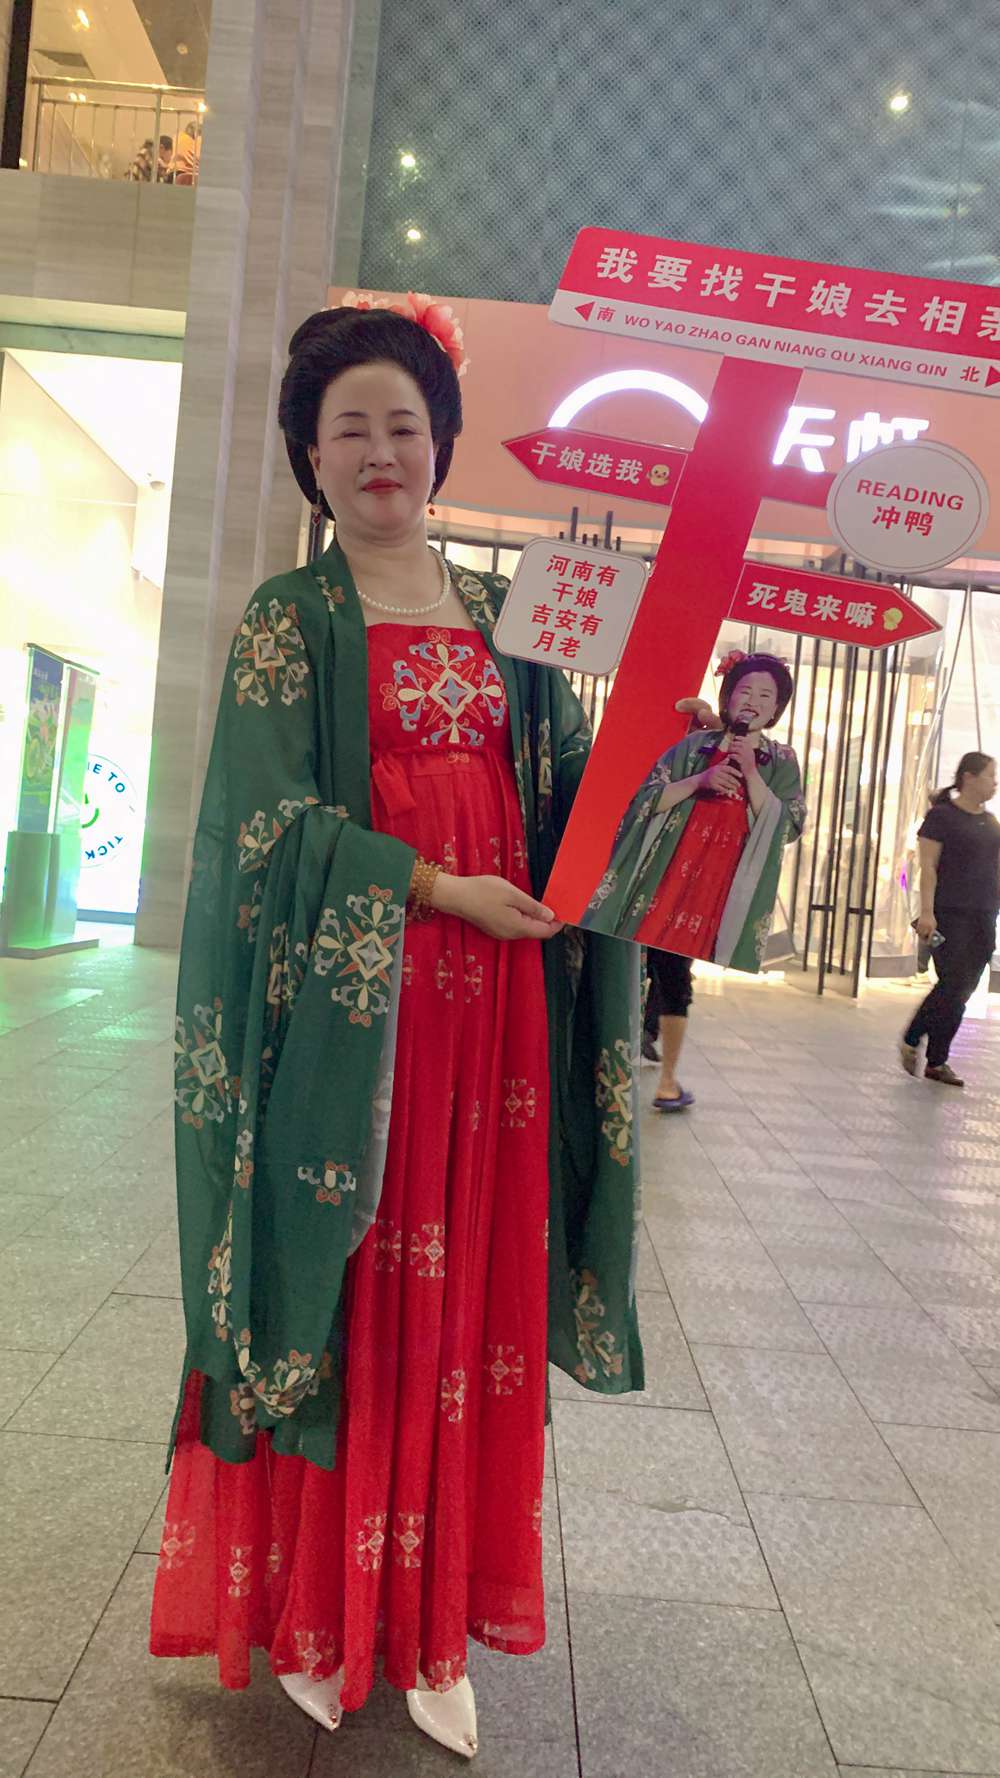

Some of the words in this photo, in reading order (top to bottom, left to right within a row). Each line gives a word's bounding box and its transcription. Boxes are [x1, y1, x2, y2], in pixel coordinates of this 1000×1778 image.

[597, 306, 616, 323] 南
[624, 314, 650, 328] WO
[654, 320, 686, 335] YAO
[688, 326, 732, 343] ZHAO
[735, 334, 771, 349] GAN
[774, 337, 826, 358] NIANG
[831, 349, 858, 363] QU
[859, 354, 912, 371] XIANG
[916, 363, 948, 377] QIN
[960, 366, 980, 382] 北
[531, 441, 643, 484] 干娘选我
[856, 479, 964, 511] READING
[872, 506, 934, 536] 冲鸭
[546, 554, 620, 587] 河南有
[552, 582, 598, 609] 干娘
[747, 582, 877, 629] 死鬼来嘛
[531, 603, 603, 636] 吉安有
[532, 630, 581, 658] 月老
